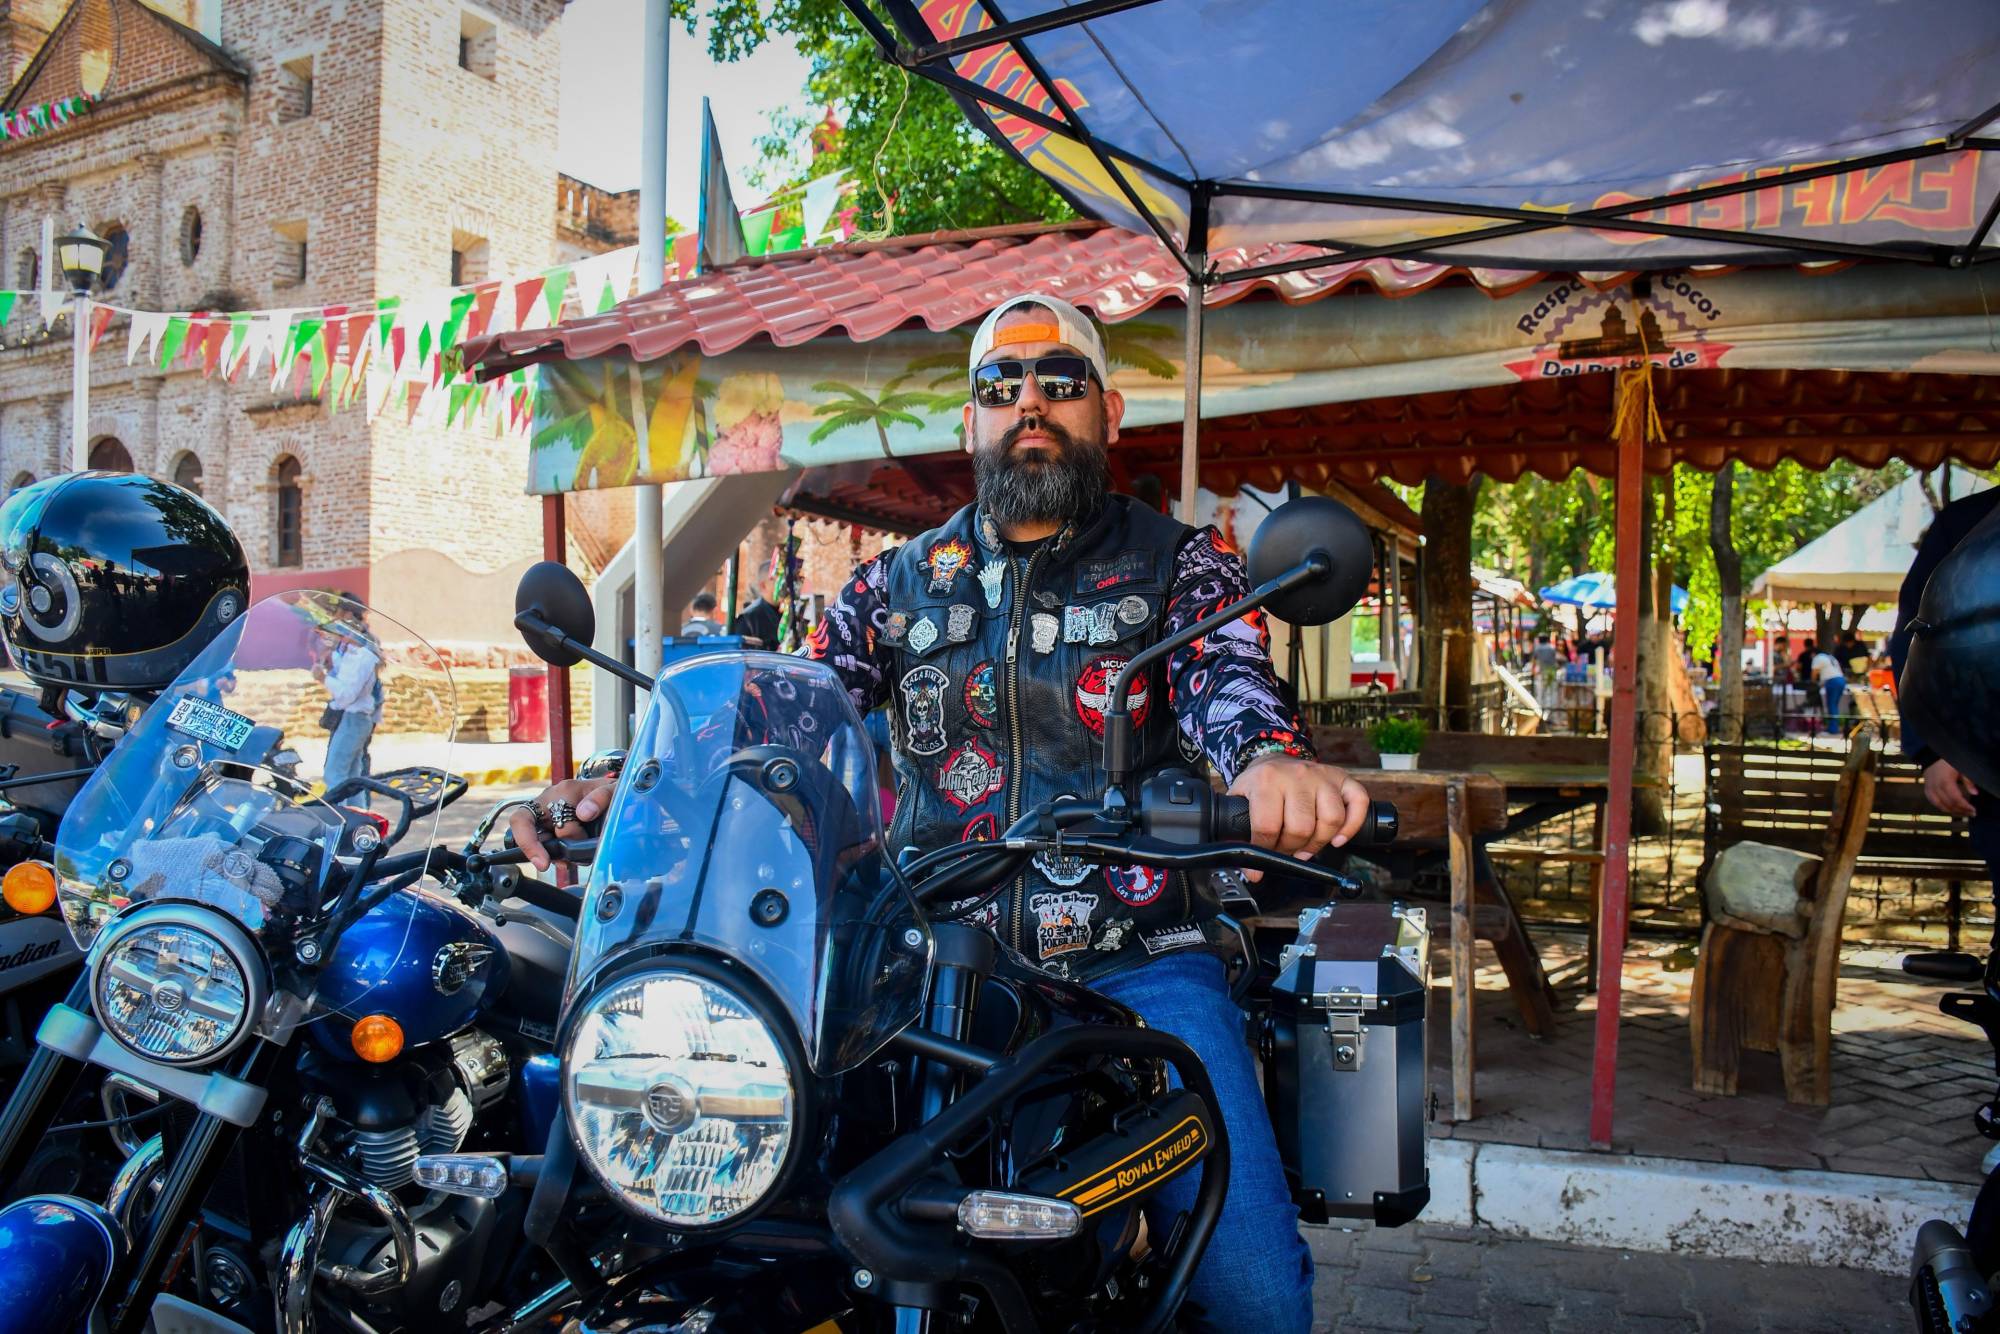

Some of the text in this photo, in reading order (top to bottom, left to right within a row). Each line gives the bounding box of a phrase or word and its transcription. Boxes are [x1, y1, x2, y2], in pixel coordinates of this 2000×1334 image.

[1661, 272, 1721, 321] Cocos
[1669, 351, 1697, 369] de
[904, 669, 945, 688] RAZA BIKER
[172, 712, 242, 745] 25 25
[179, 702, 190, 712] 20
[235, 724, 248, 736] 20
[938, 766, 1003, 791] BAHIA BIKER
[1117, 885, 1129, 898] Los
[1040, 927, 1054, 938] 20
[1042, 937, 1069, 951] POKER
[0, 940, 60, 971] ndian
[1117, 1135, 1192, 1189] ROYAL ENFIELD
